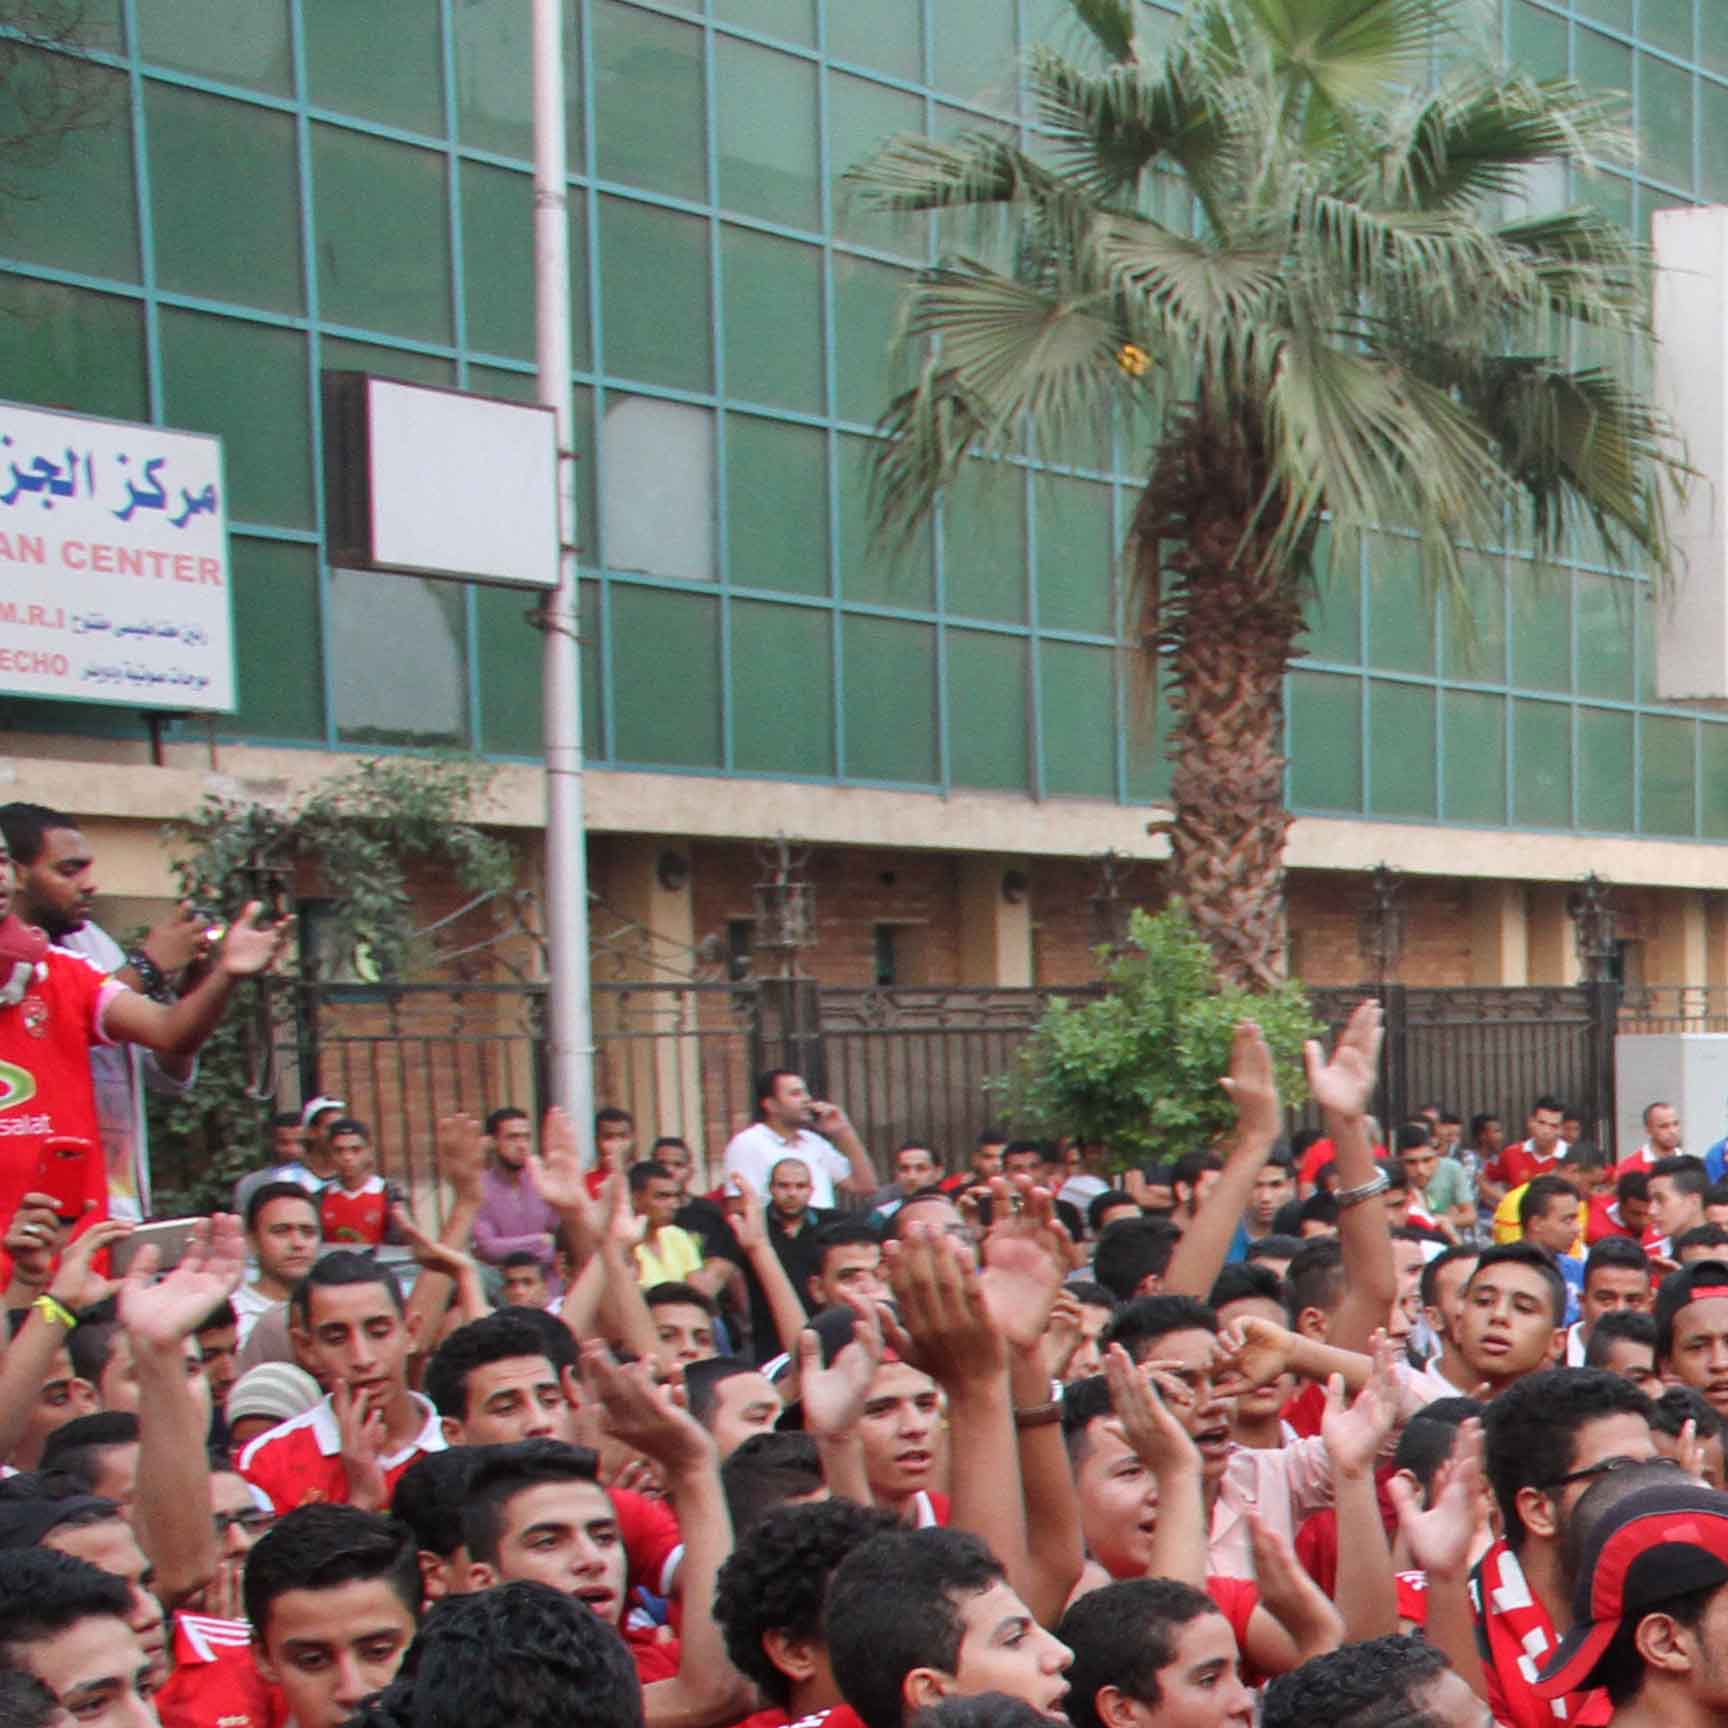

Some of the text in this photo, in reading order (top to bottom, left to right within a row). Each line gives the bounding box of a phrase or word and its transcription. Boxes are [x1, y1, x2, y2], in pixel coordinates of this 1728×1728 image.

[110, 450, 218, 530] مركز
[60, 539, 224, 587] CENTER
[0, 648, 69, 678] ECHO
